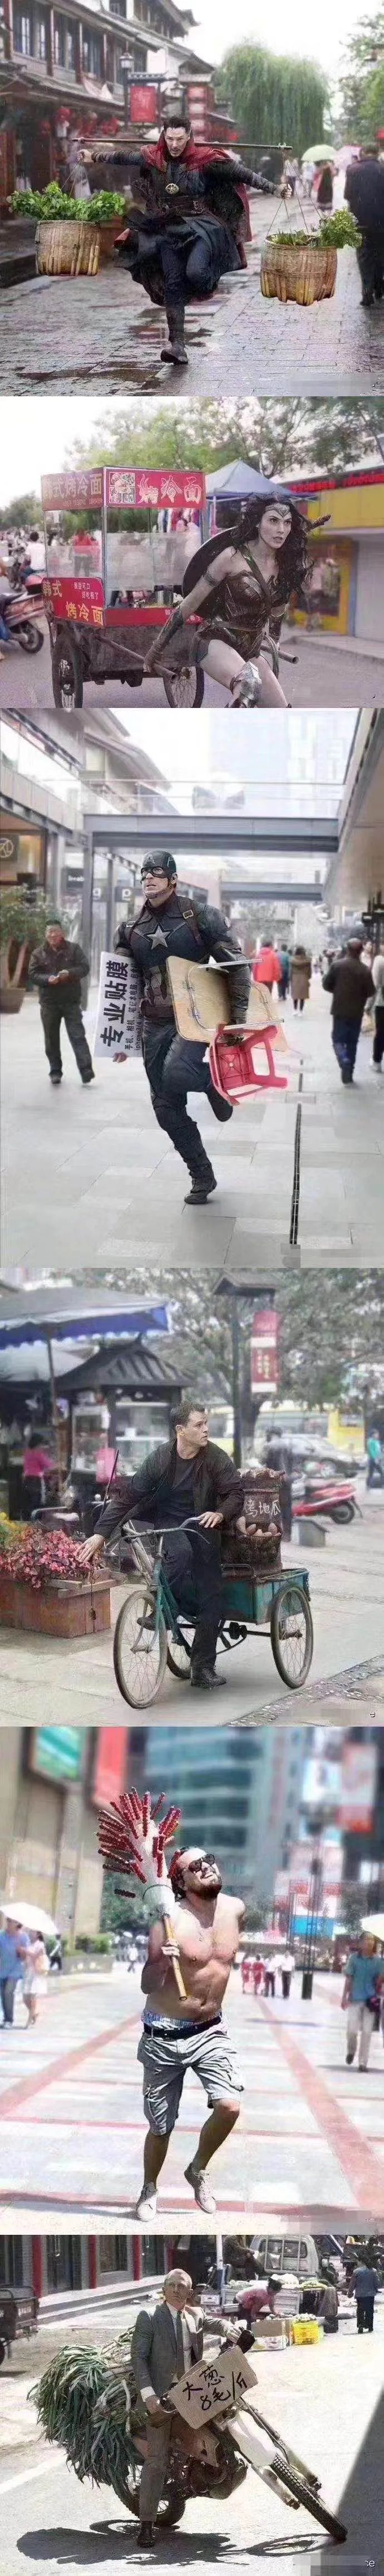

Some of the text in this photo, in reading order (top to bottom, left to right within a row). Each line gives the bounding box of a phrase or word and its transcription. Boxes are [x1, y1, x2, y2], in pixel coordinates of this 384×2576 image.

[137, 473, 202, 504] 烤冷面
[43, 580, 62, 597] 韩式
[66, 601, 104, 626] 烤冷面
[100, 960, 129, 1047] 专业贴膜
[243, 1498, 281, 1518] 烤地瓜
[182, 2364, 225, 2401] 大葱
